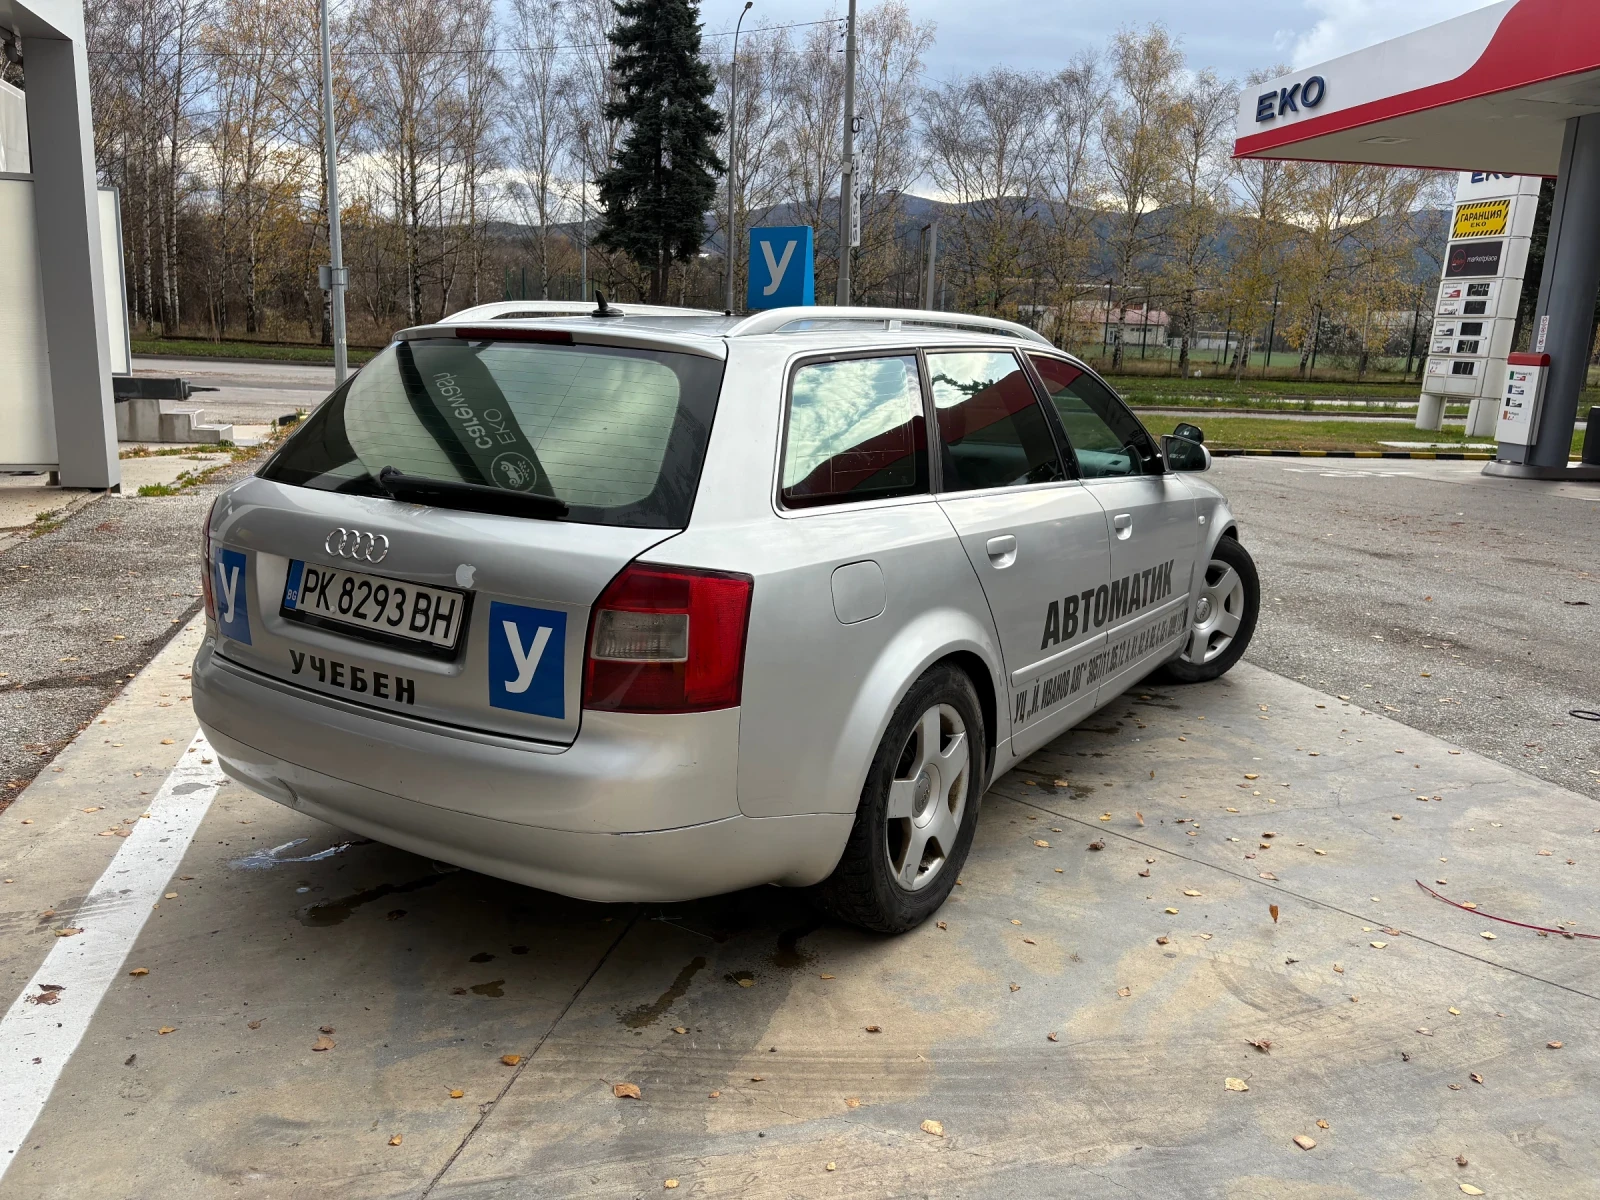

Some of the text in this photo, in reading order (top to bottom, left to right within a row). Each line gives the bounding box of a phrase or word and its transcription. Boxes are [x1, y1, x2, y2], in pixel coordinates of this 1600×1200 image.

[1256, 76, 1325, 122] EKO
[1460, 209, 1502, 222] ГАРАНЦИЯ
[1467, 255, 1498, 263] marketplace
[287, 589, 298, 601] BG
[337, 576, 407, 627] 8293
[1040, 558, 1175, 650] АВТОМАТИК
[288, 648, 416, 706] УЧЕБЕН
[1041, 669, 1071, 710] ИВАНОВ
